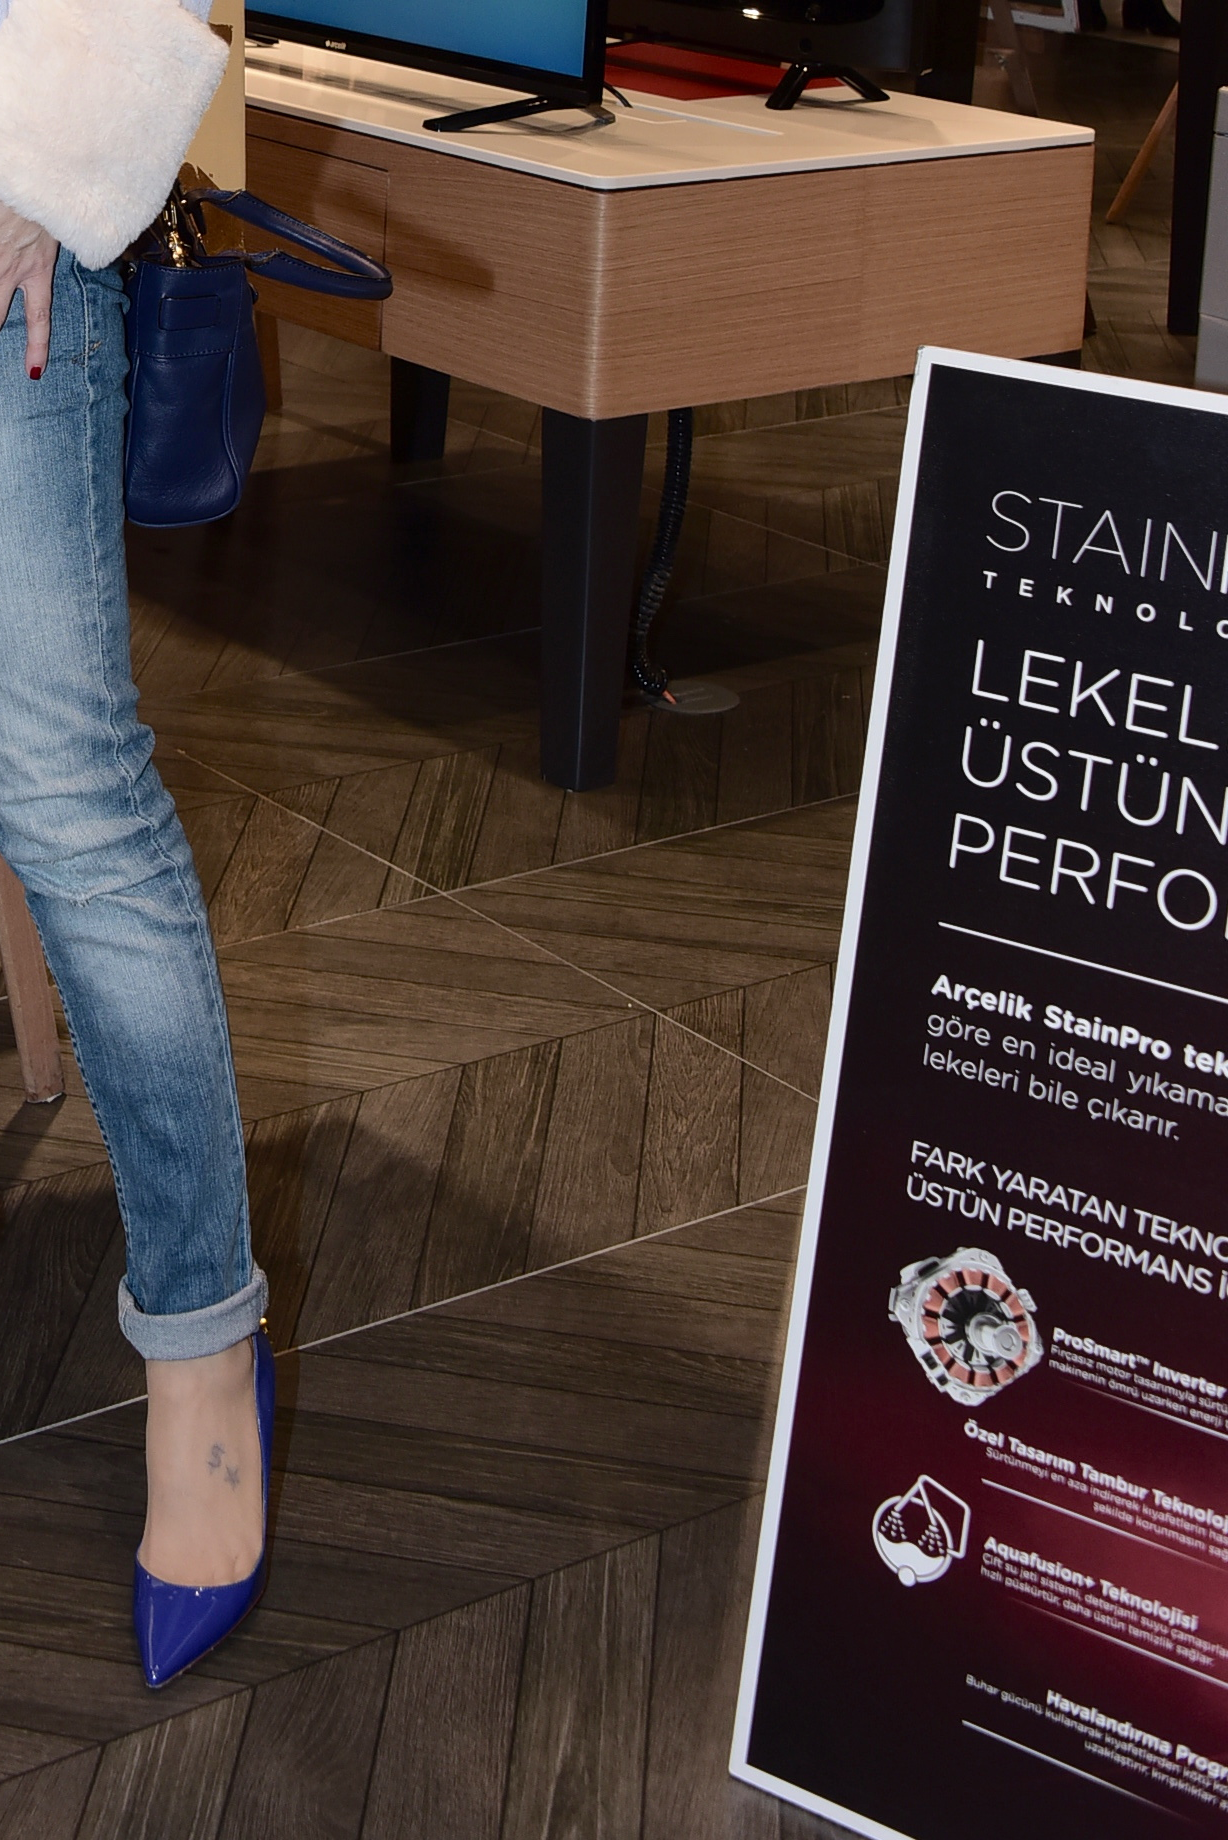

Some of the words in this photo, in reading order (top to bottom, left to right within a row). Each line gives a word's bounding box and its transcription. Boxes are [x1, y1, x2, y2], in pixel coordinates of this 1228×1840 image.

[985, 490, 1228, 594] STAIN
[971, 640, 1219, 750] LEKEL
[962, 718, 1228, 845] ÜSTÜN
[949, 813, 1228, 939] PERFO
[927, 1013, 991, 1047] göre
[1002, 1035, 1036, 1060] en
[1048, 1042, 1116, 1083] ideal
[931, 975, 1033, 1022] Arçelik
[1043, 1005, 1172, 1060] StainPro
[923, 1043, 1020, 1093] lekeleri
[1029, 1074, 1079, 1110] bile
[1087, 1098, 1180, 1141] çıkarır.
[911, 1140, 986, 1185] FARK
[992, 1164, 1126, 1229] YARATAN
[907, 1172, 1001, 1227] ÜSTÜN
[1007, 1207, 1213, 1295] PERFORMANS
[1049, 1359, 1107, 1386] makinenin
[1108, 1379, 1140, 1398] ömrü
[1141, 1391, 1188, 1414] uzarken
[1190, 1408, 1222, 1428] enerji
[1096, 1361, 1132, 1380] motor
[1153, 1361, 1227, 1399] Inverter
[964, 1418, 1004, 1448] Özel
[1008, 1436, 1076, 1475] Tasarım
[1080, 1462, 1149, 1500] Tambur
[1051, 1472, 1066, 1485] en
[1068, 1478, 1088, 1493] aza
[1090, 1485, 1139, 1511] indirerek
[984, 1536, 1096, 1588] Aquafusion+
[1100, 1579, 1199, 1631] Teknolojisi
[1046, 1689, 1172, 1755] Havalandırma
